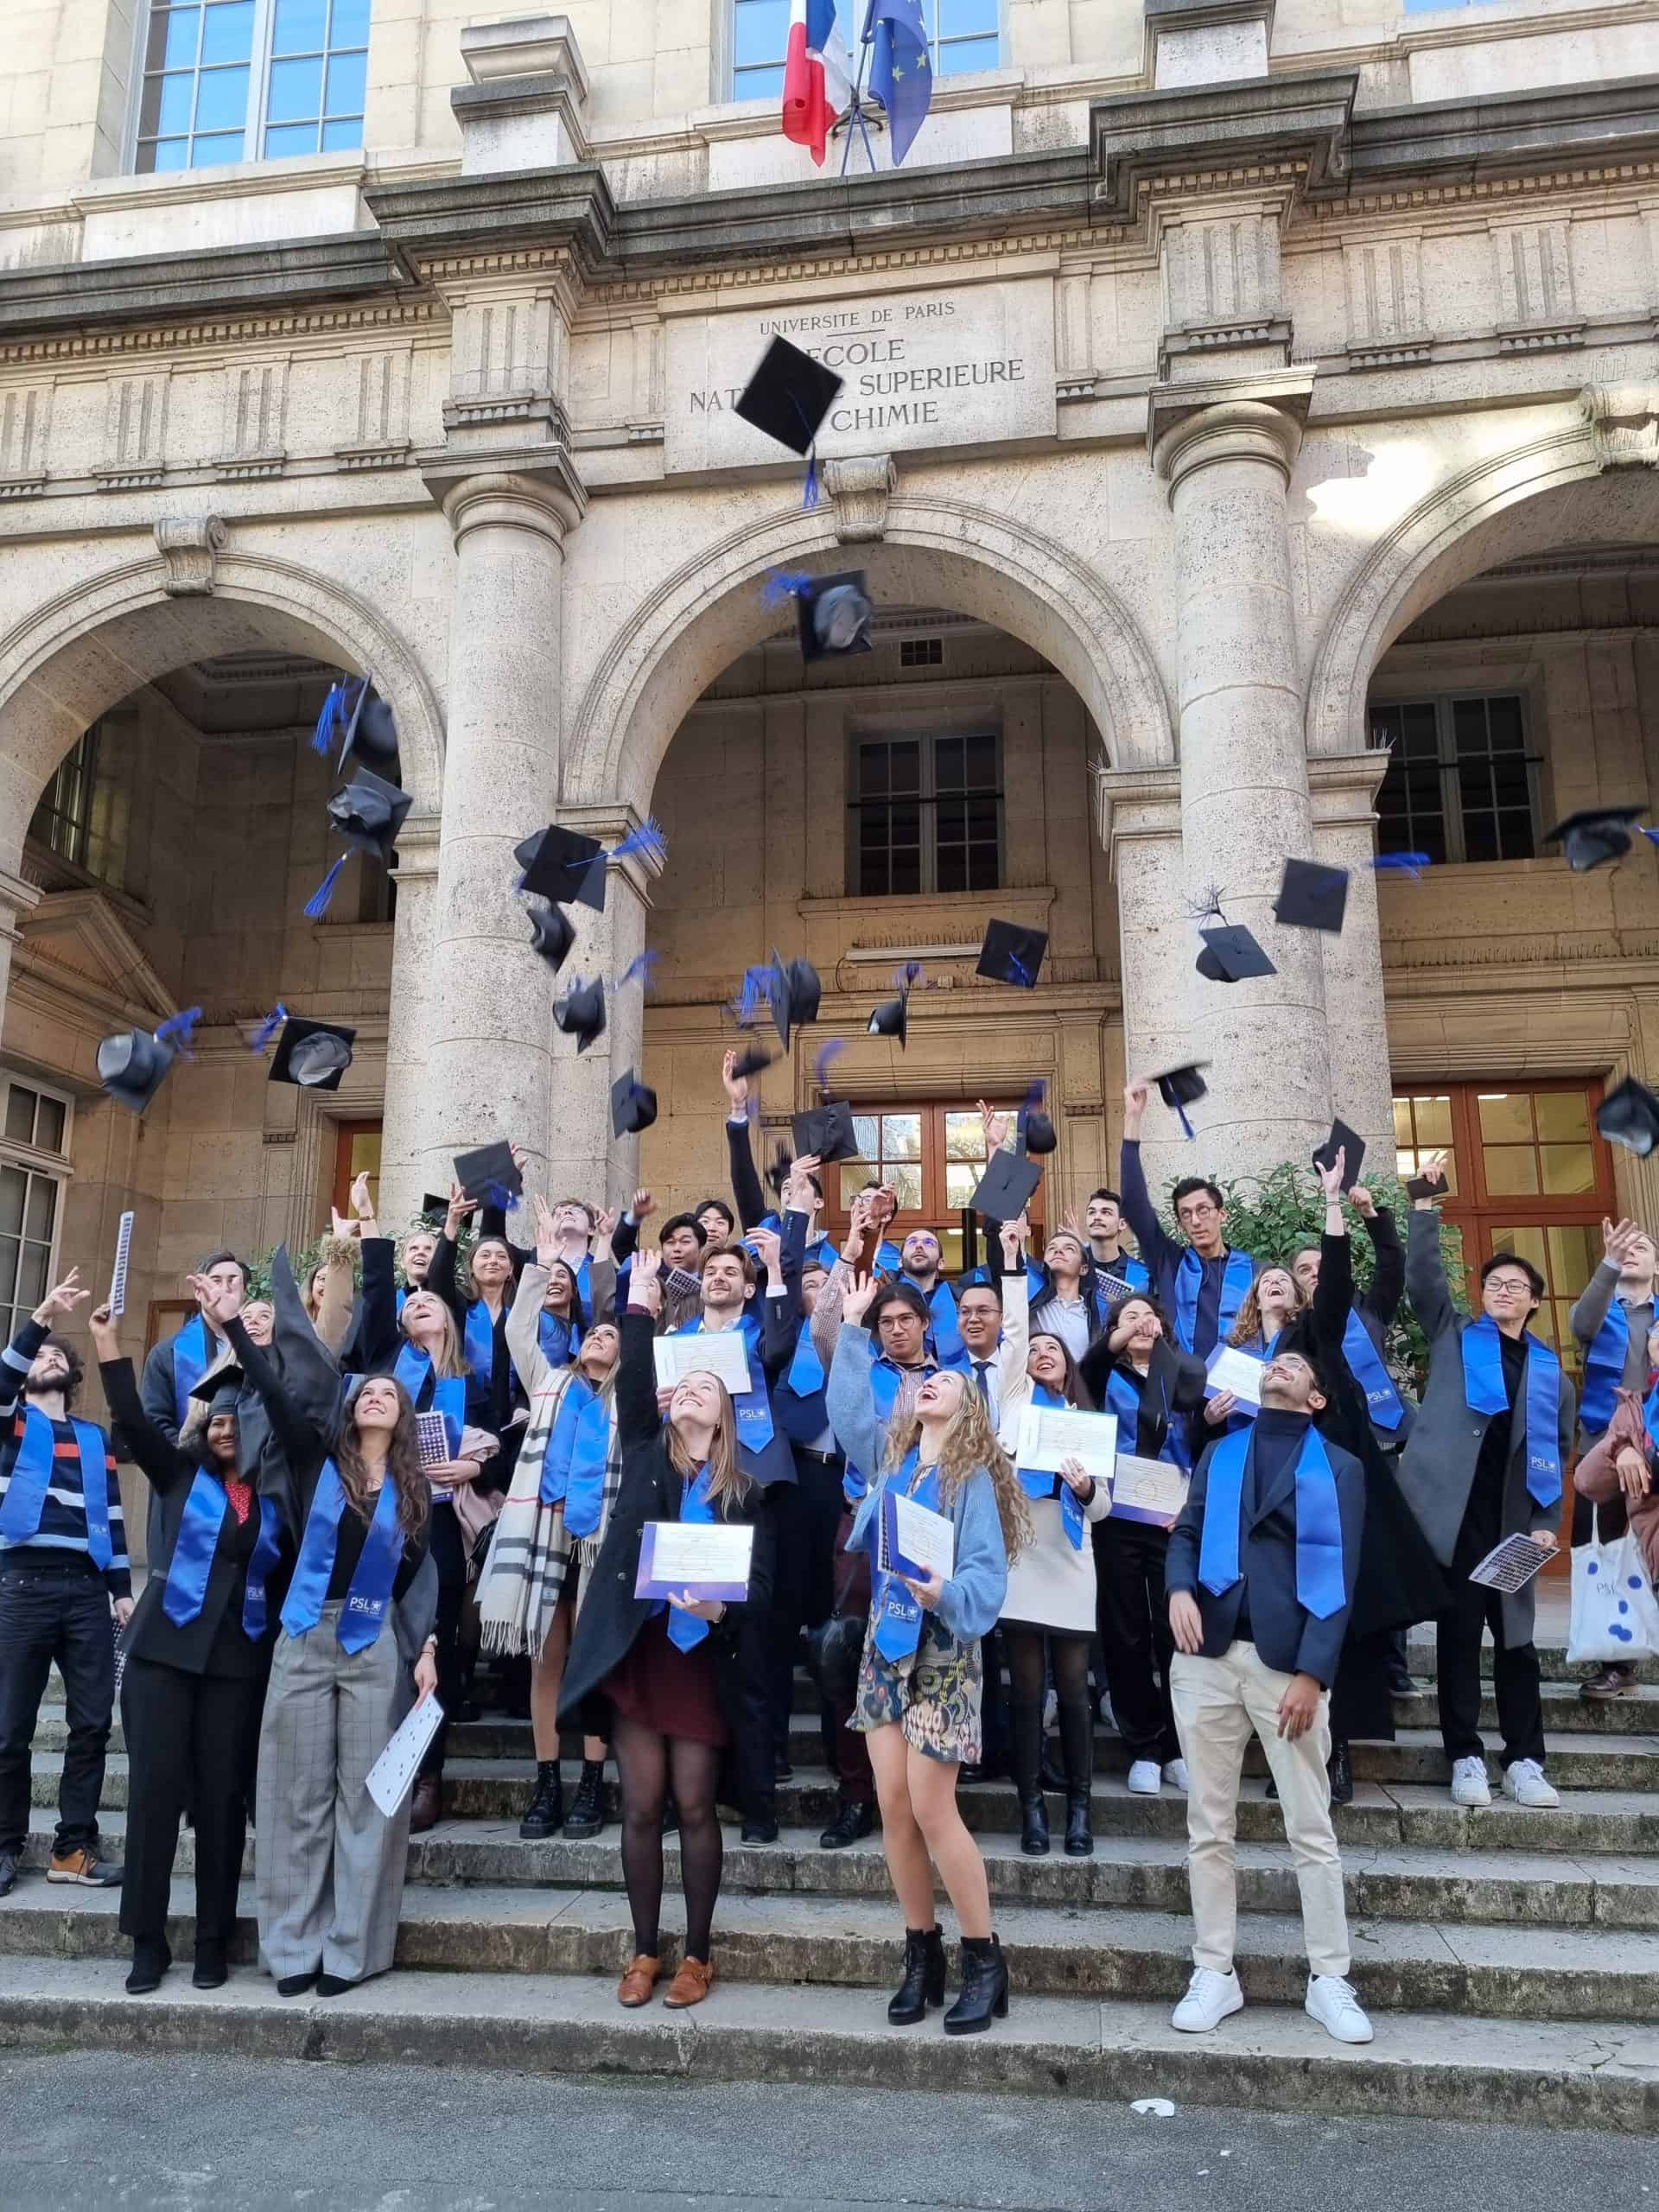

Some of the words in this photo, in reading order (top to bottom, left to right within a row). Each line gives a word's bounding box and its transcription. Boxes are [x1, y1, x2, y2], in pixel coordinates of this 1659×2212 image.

[760, 312, 860, 335] UNIVERSITE
[871, 308, 893, 324] DE
[905, 302, 955, 320] PARIS
[860, 359, 1025, 396] SUPERIEURE
[830, 401, 938, 432] CHIMIE
[1368, 1391, 1383, 1401] PSL
[740, 1409, 758, 1418] PSL
[1531, 1457, 1548, 1469] PSL
[349, 1597, 370, 1611] PSL
[888, 1602, 906, 1616] PSL
